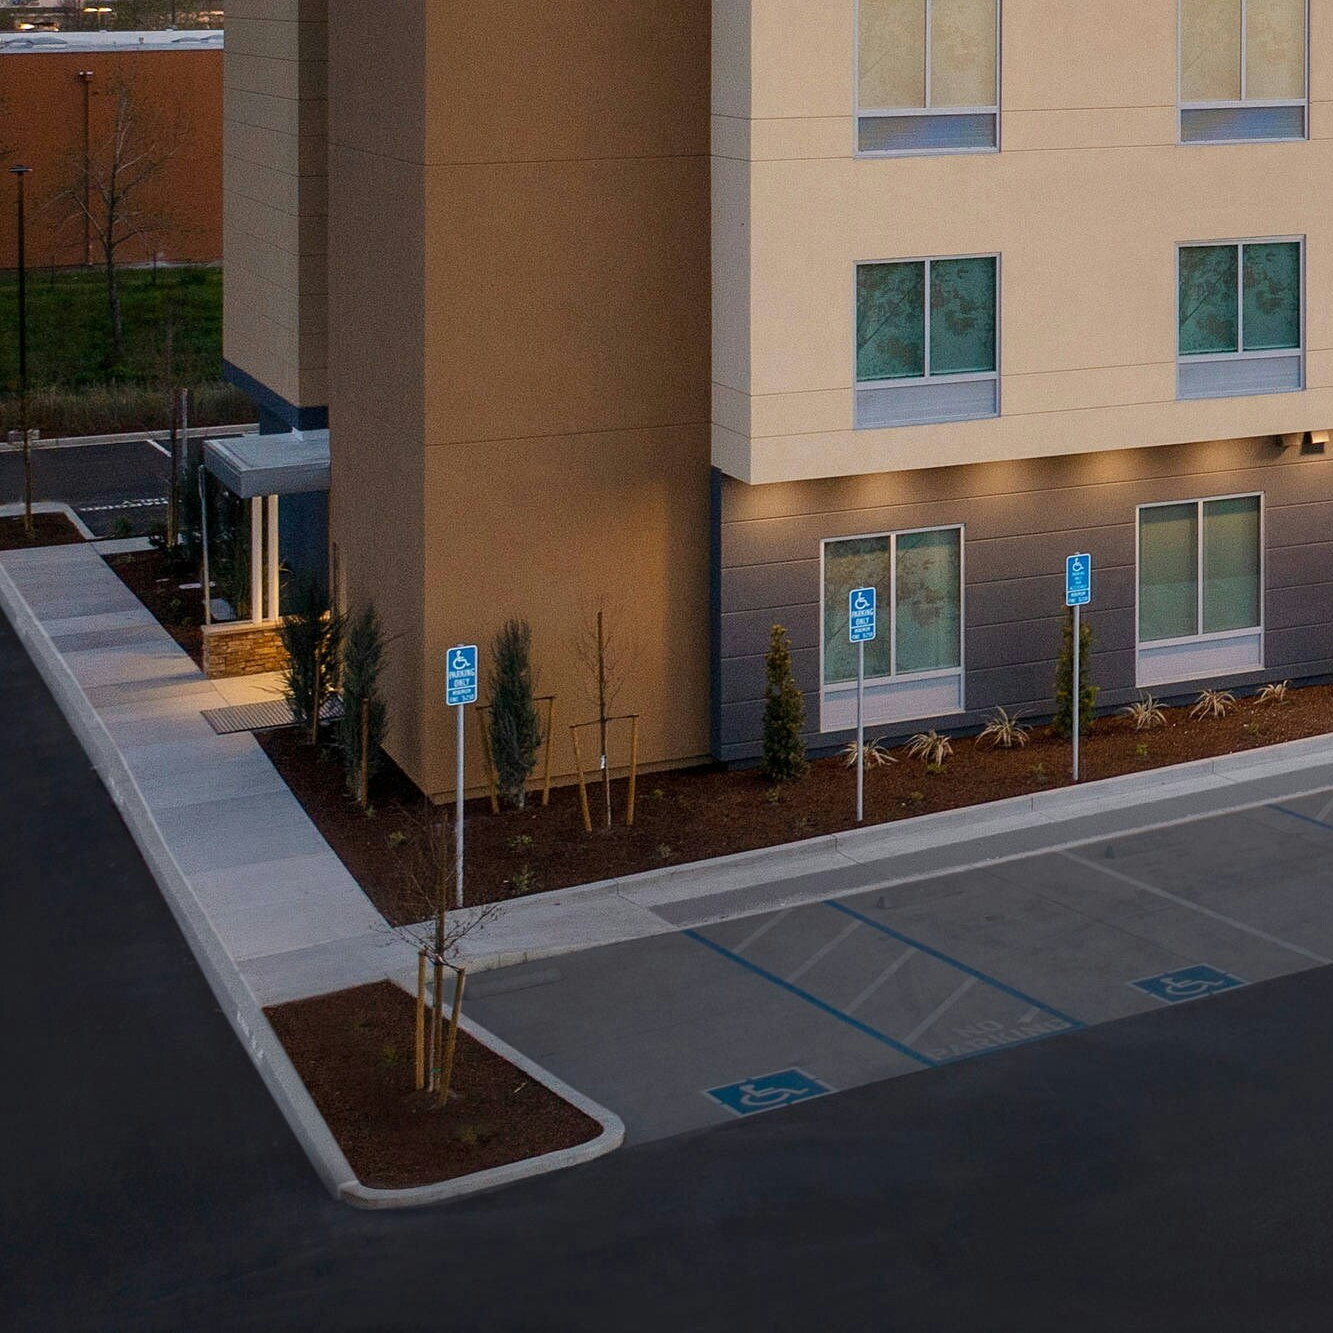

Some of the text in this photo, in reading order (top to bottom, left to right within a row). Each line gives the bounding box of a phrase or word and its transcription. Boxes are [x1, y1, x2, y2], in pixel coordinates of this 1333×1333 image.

[448, 668, 475, 679] PARKING
[454, 678, 470, 687] ONLY
[951, 1020, 1003, 1037] NO
[925, 1018, 1072, 1060] PARKING
